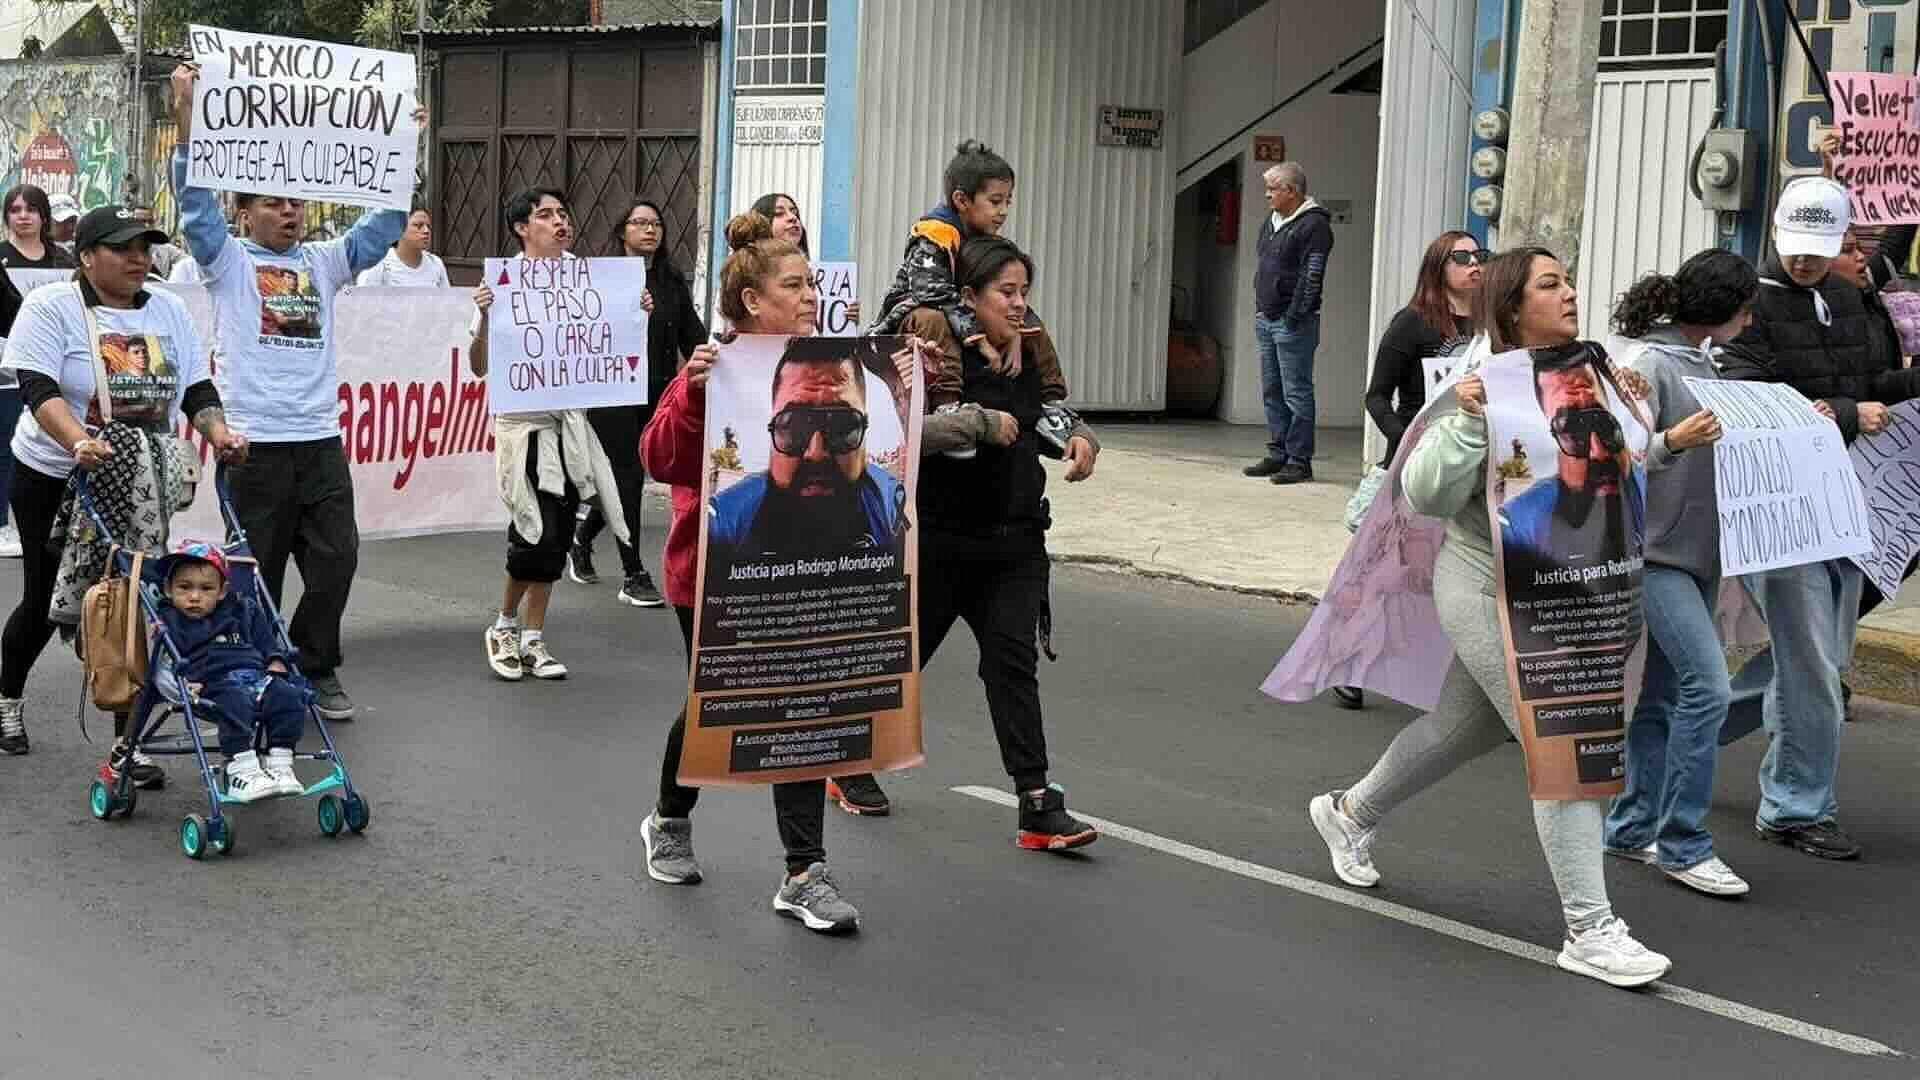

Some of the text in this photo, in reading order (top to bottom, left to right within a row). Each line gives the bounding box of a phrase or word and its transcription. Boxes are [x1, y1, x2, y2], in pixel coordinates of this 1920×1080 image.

[191, 31, 224, 54] EN
[229, 41, 384, 82] MÉXICO LA
[203, 82, 402, 136] CORRUPCIÓN
[1833, 78, 1915, 120] Velvet
[1841, 121, 1920, 157] Escucha
[192, 139, 401, 193] PROTEGE AL CULPABLE
[1834, 156, 1920, 191] seguimos
[1882, 189, 1920, 219] luch
[520, 256, 592, 289] RESPETA
[829, 270, 852, 298] LA
[511, 288, 602, 325] EL PASO
[523, 322, 612, 359] O CARGA
[509, 360, 545, 391] CON
[552, 360, 569, 387] LA
[1717, 437, 1793, 500] RODRIGO
[1720, 495, 1822, 570] MONDRAGON
[728, 551, 894, 580] Justicia para Rodrigo Mondragón
[1533, 566, 1581, 585] Justicia
[1582, 562, 1607, 583] para
